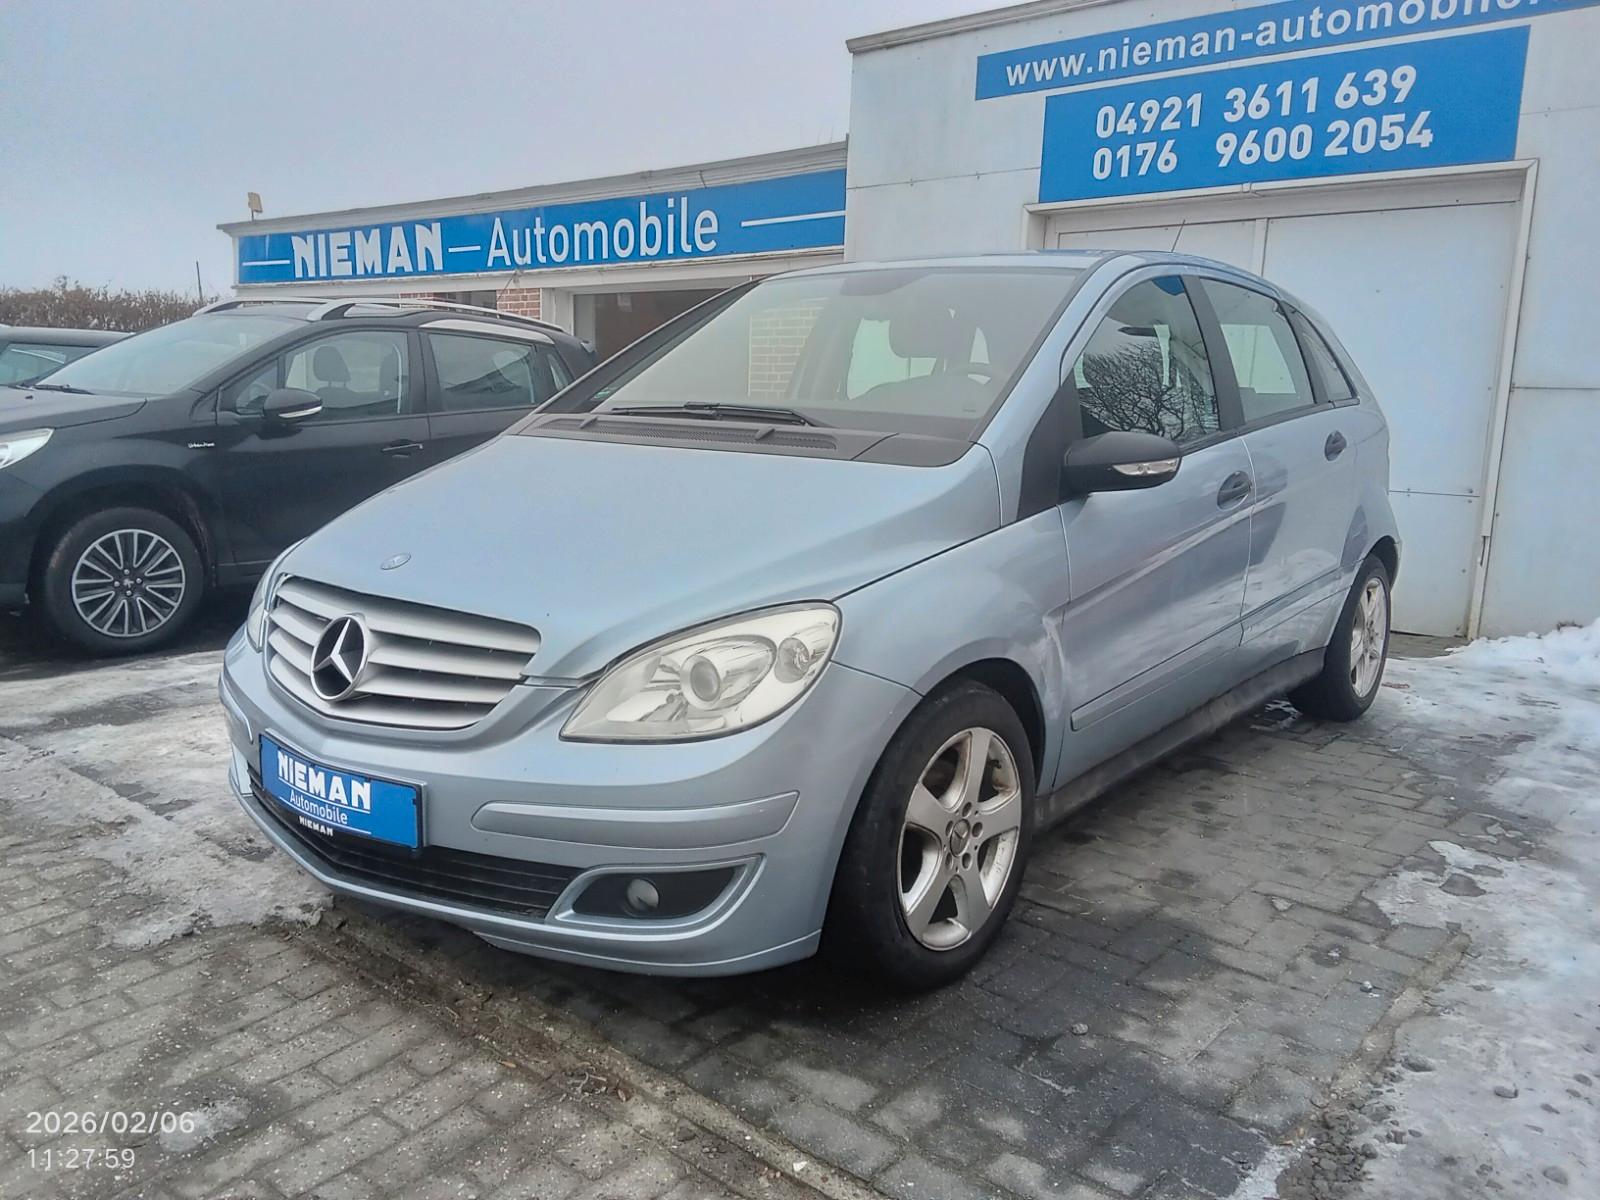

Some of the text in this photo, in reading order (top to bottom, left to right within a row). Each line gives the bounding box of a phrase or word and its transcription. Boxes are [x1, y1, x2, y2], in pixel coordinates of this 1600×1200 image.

[1095, 65, 1417, 139] 04921 3611 639
[1093, 110, 1434, 180] 0176 9600 2054
[291, 196, 719, 279] NIEMAN Automobile
[277, 750, 371, 809] NIEMAN
[290, 790, 348, 824] Automobile
[299, 816, 333, 836] NIEMAN
